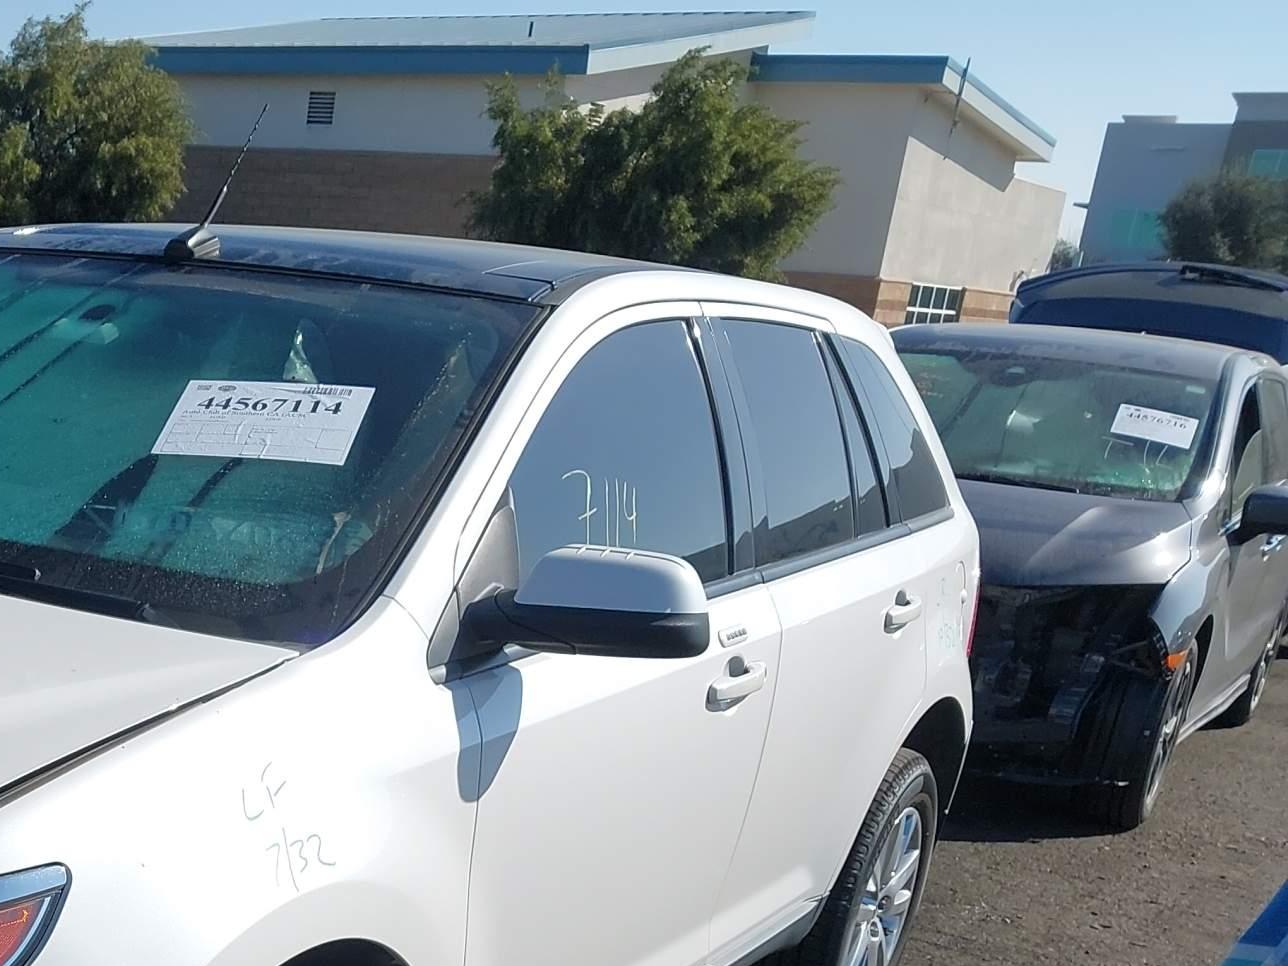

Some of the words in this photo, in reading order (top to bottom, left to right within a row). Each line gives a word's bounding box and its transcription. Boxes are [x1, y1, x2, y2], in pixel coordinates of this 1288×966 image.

[197, 396, 342, 415] 44567114
[561, 469, 637, 547] 7114
[264, 826, 337, 893] 7/32
